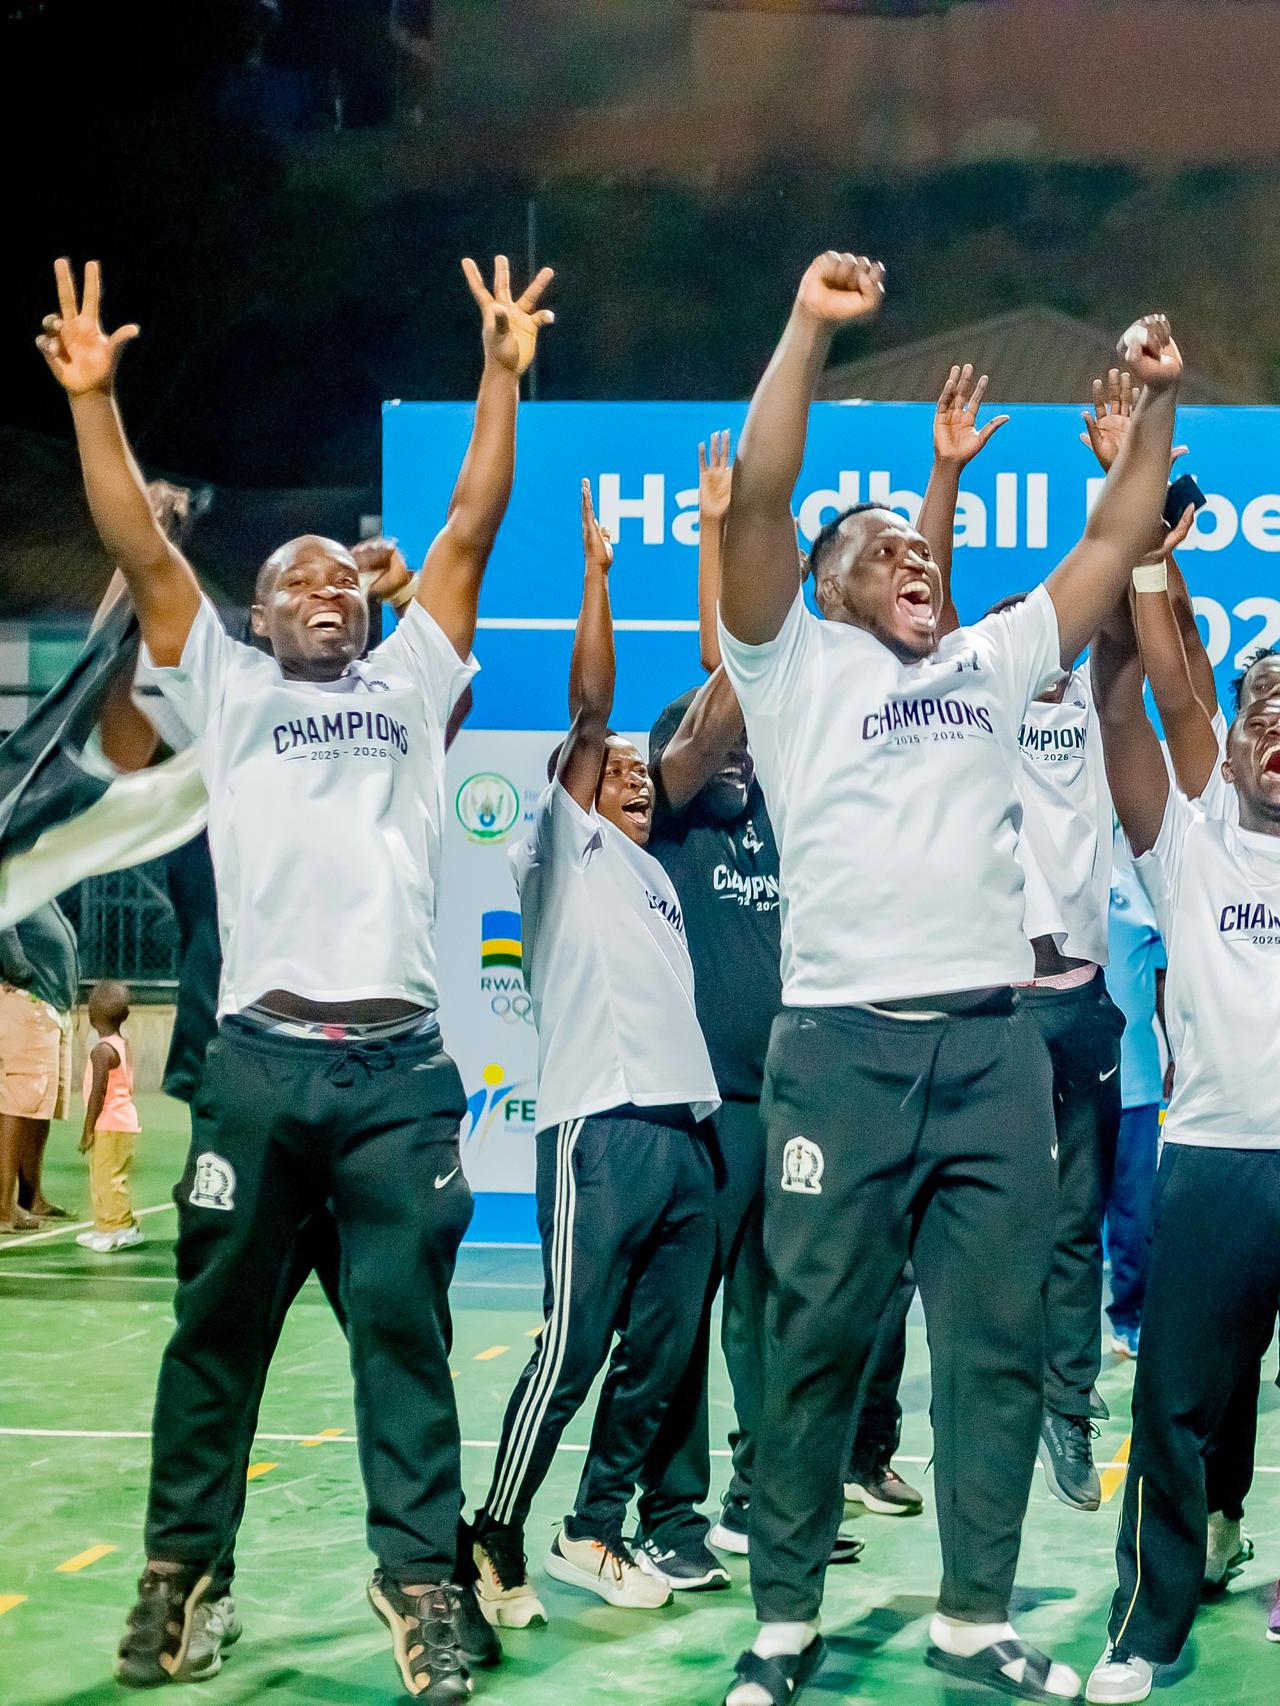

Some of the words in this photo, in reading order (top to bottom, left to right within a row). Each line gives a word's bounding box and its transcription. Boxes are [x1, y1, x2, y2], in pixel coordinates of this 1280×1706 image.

[599, 470, 1048, 548] Hadball
[862, 698, 993, 740] CHAMPIONS
[273, 711, 408, 755] CHAMPIONS
[311, 749, 340, 761] 2025
[353, 746, 387, 758] 2026
[1252, 935, 1280, 945] 2025
[481, 977, 522, 991] RWA
[505, 1099, 537, 1121] FE
